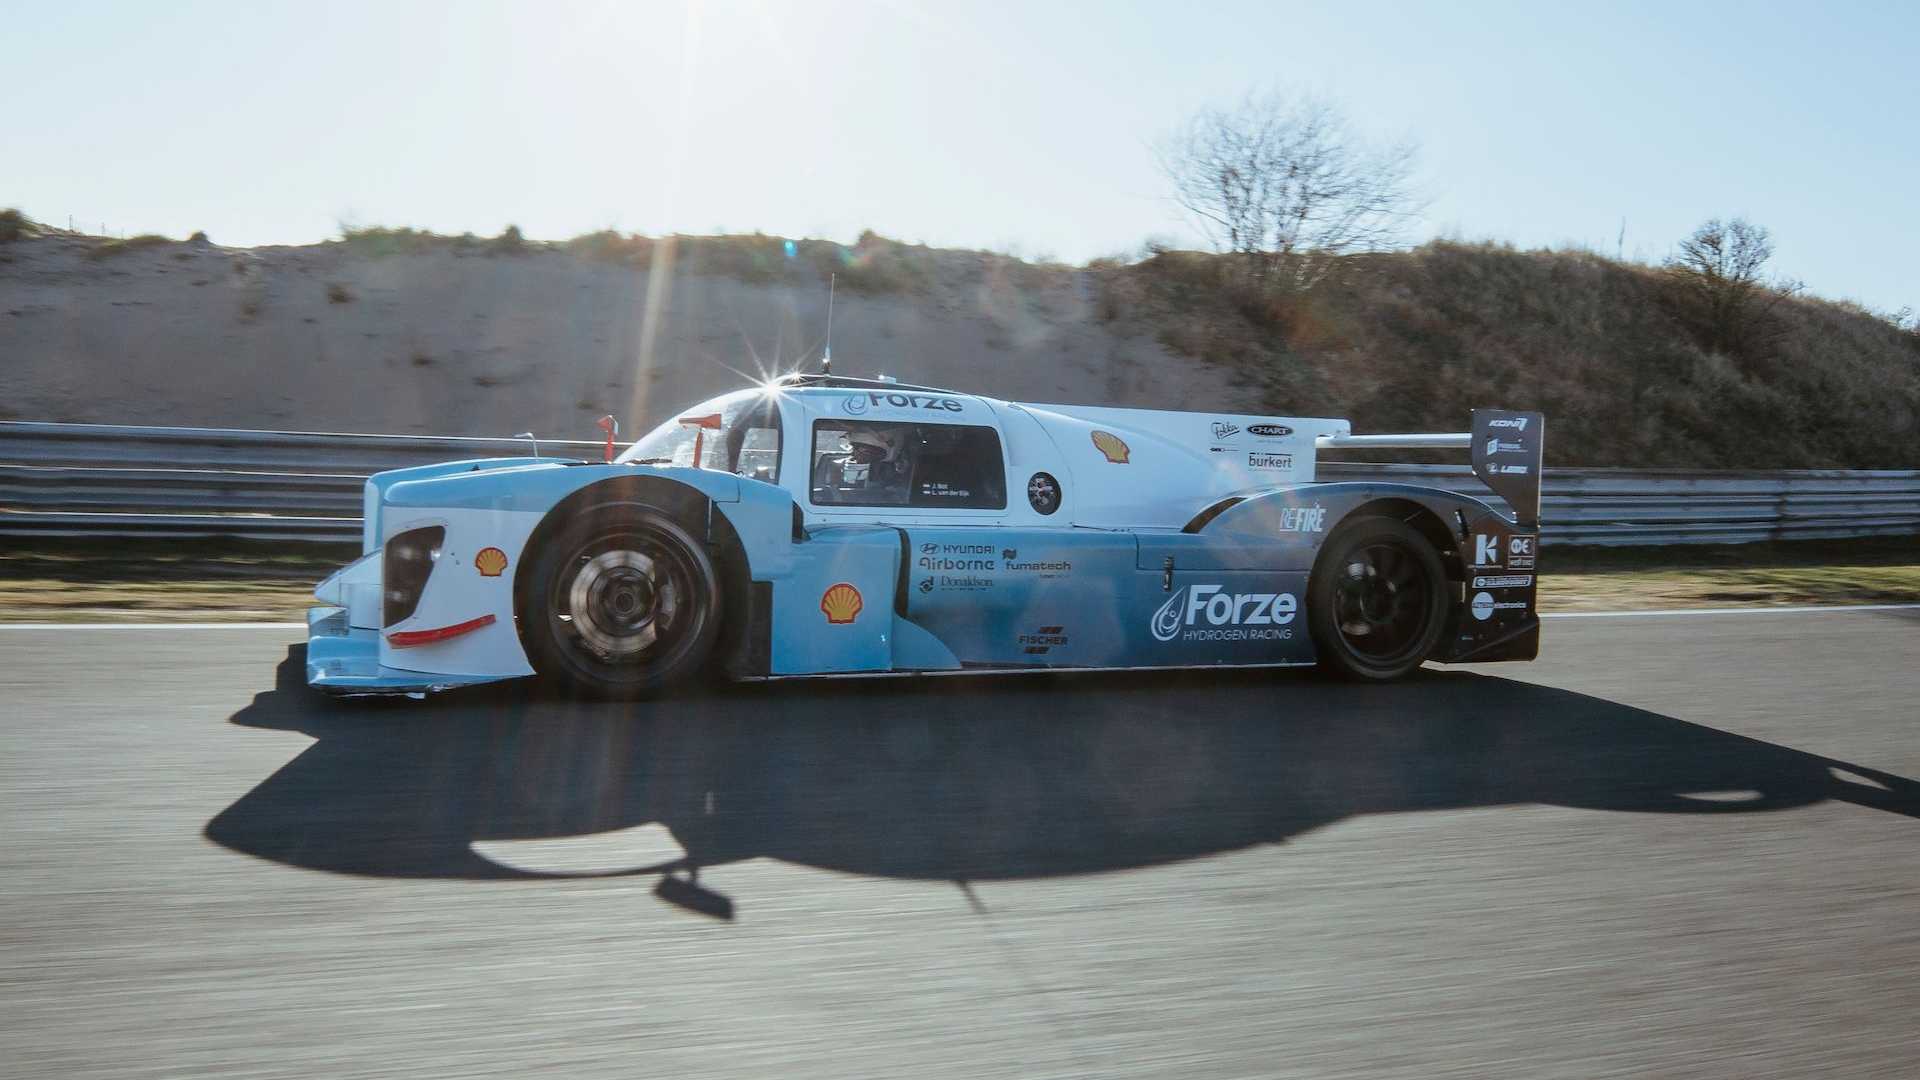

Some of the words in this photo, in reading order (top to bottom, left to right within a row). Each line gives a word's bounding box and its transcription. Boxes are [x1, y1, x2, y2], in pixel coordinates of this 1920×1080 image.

[1488, 417, 1528, 431] KONI
[1250, 426, 1289, 435] CHART
[943, 544, 995, 554] HYUNDAI
[919, 557, 995, 570] Airborne
[1006, 561, 1072, 570] fumatech
[941, 576, 993, 587] Donaldson
[1185, 585, 1297, 625] Forze
[1018, 635, 1068, 646] FISCHER
[1183, 629, 1248, 641] HYDROGEN
[1250, 629, 1293, 640] RACING
